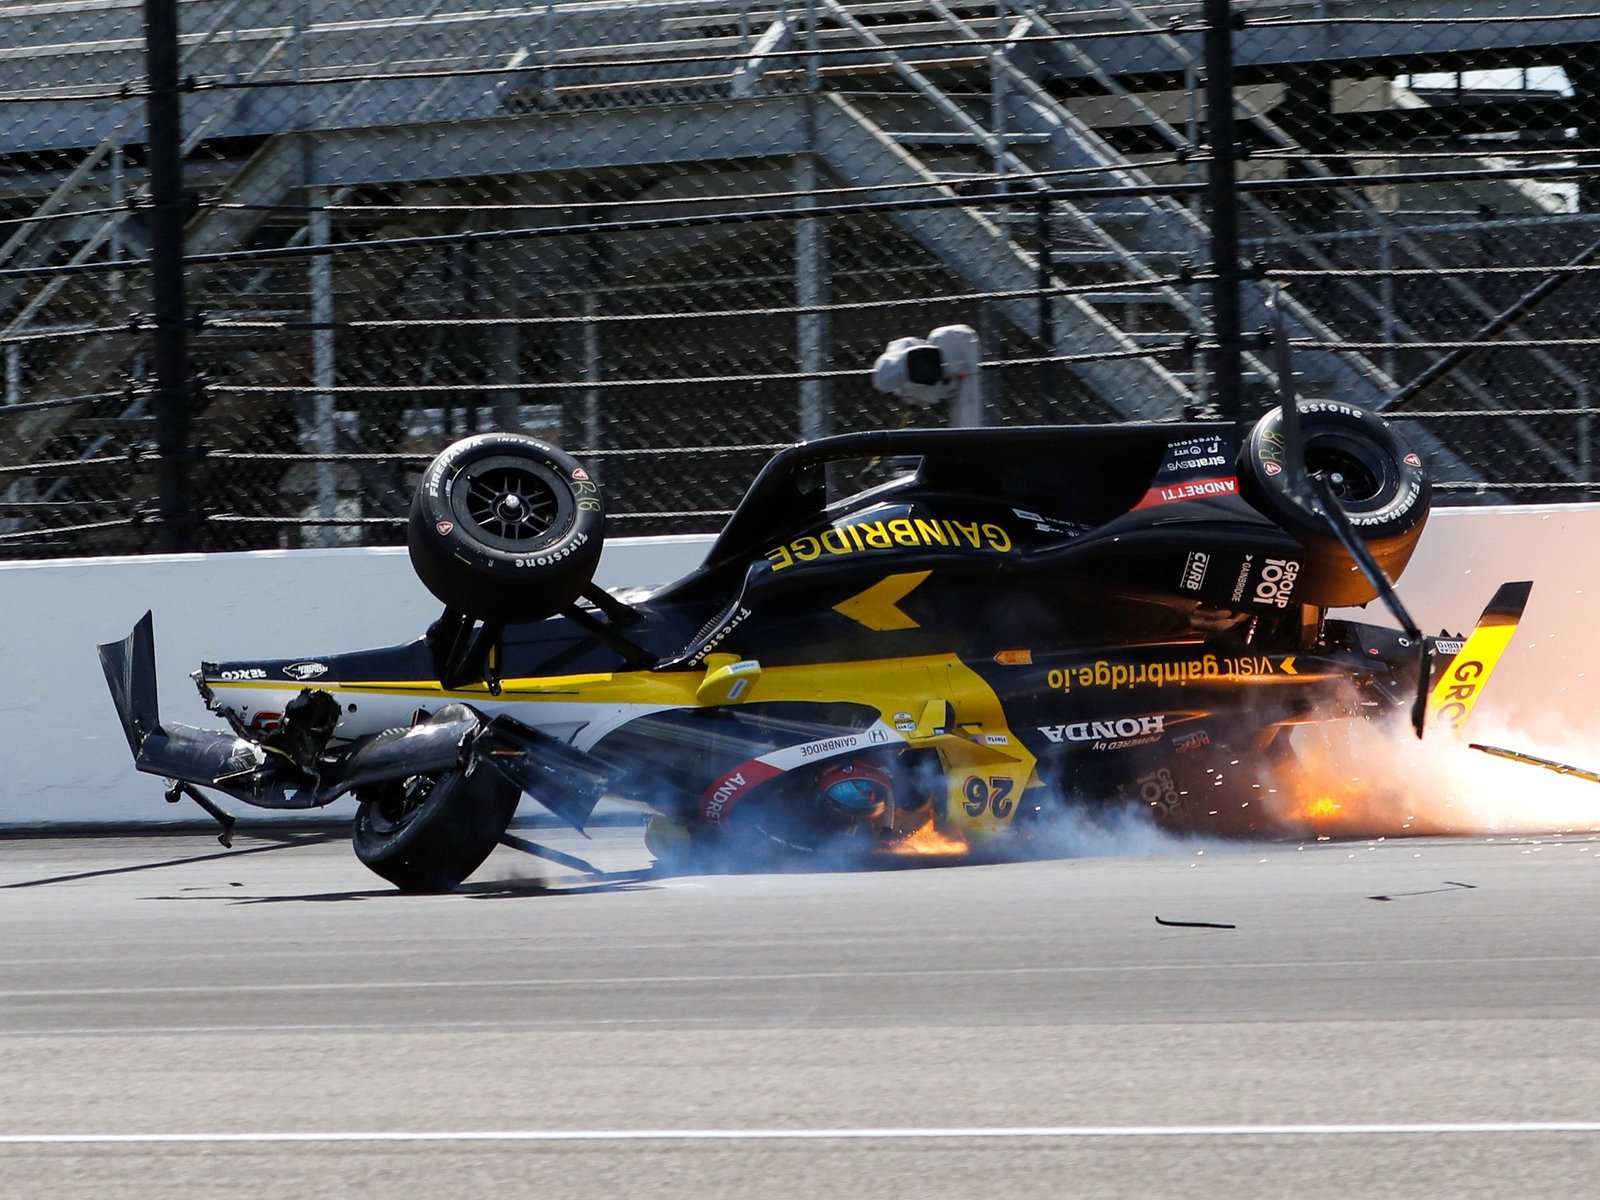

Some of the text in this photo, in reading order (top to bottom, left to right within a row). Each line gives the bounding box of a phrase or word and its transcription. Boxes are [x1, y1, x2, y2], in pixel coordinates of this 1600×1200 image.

[1277, 402, 1363, 421] estone
[1167, 435, 1222, 448] Firestone
[429, 437, 485, 498] FIREHAWK
[1166, 455, 1227, 472] stratasys
[1161, 480, 1235, 501] ANDRETTI
[1349, 481, 1421, 526] FIREHAWK
[514, 532, 589, 568] Firestone
[764, 517, 1012, 572] GAINBRIDGE
[1186, 552, 1207, 591] CURB
[1231, 562, 1251, 602] GAINBRIDGE
[1252, 558, 1287, 605] 1001
[1274, 561, 1300, 609] GROUP
[688, 606, 752, 667] Firestone
[1047, 654, 1274, 694] visit gainbridge.io
[1437, 660, 1483, 730] GRO
[800, 736, 857, 758] GAINBRIDGE
[987, 736, 1007, 744] Herta
[1037, 715, 1166, 744] HONDA
[1092, 741, 1107, 751] by
[1108, 735, 1162, 750] POWERED
[961, 775, 1015, 819] 26
